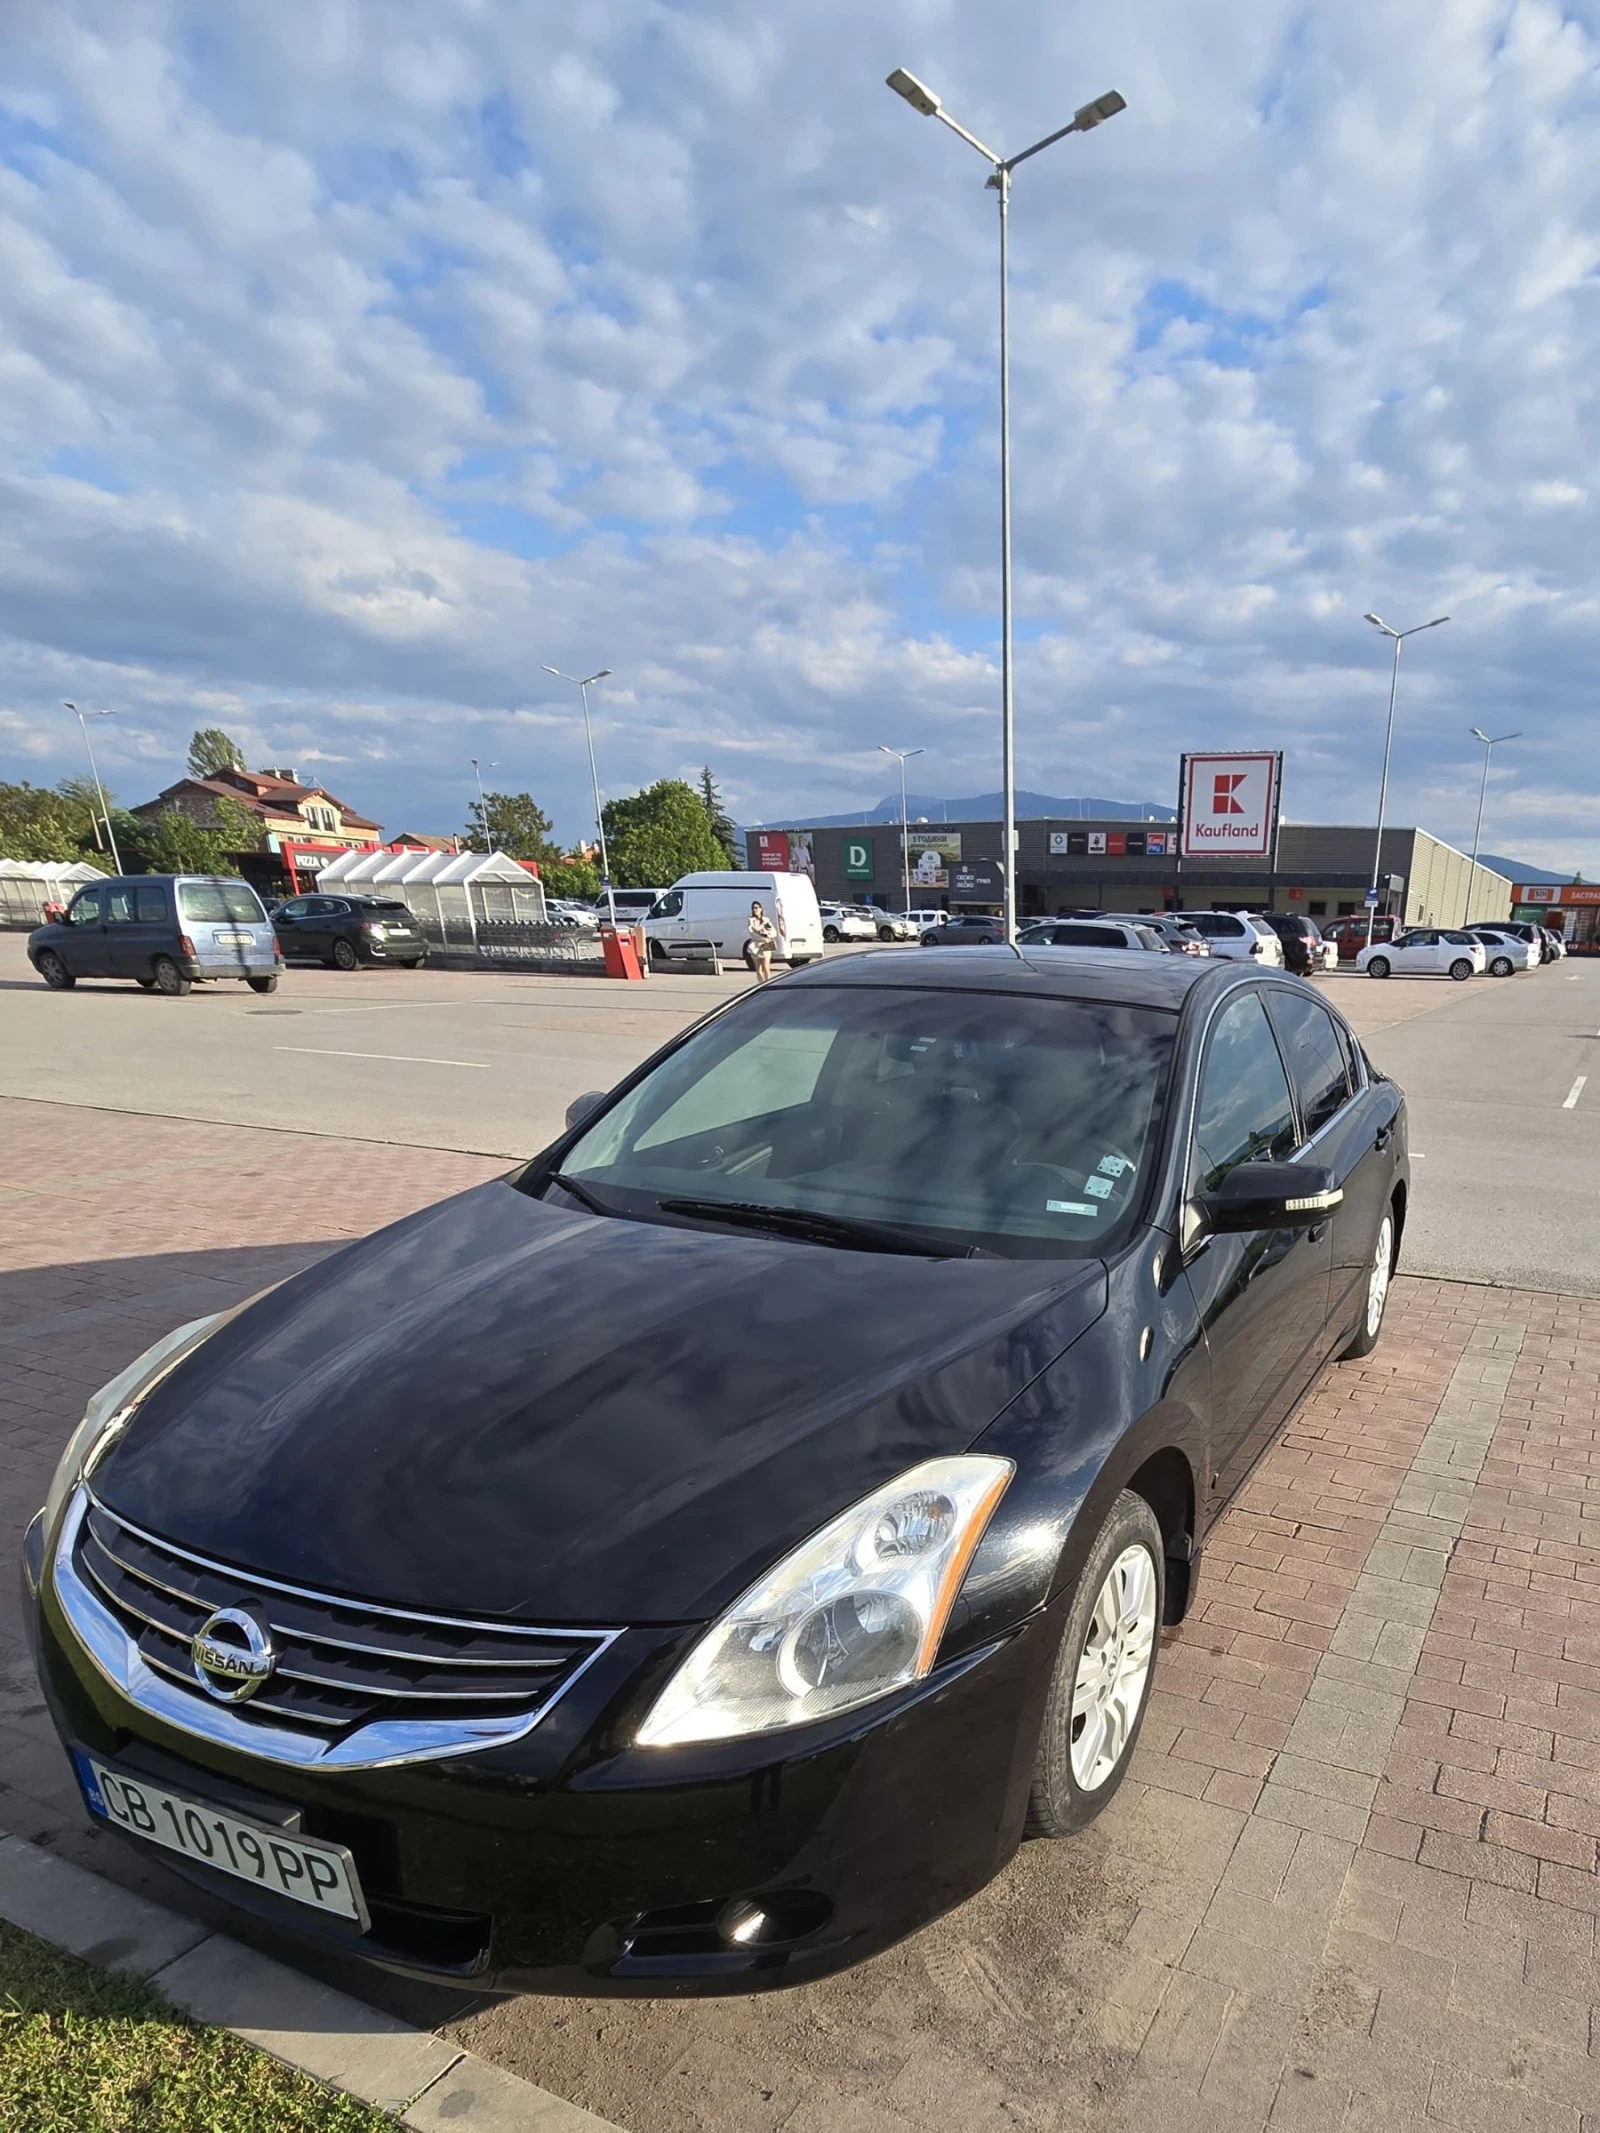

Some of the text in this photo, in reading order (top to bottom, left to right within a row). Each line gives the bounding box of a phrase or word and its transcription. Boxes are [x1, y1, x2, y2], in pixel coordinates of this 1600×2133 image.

[1195, 823, 1259, 837] Kaufland
[295, 855, 321, 868] PIZZA
[850, 846, 867, 867] D
[192, 1643, 255, 1675] NISSAN
